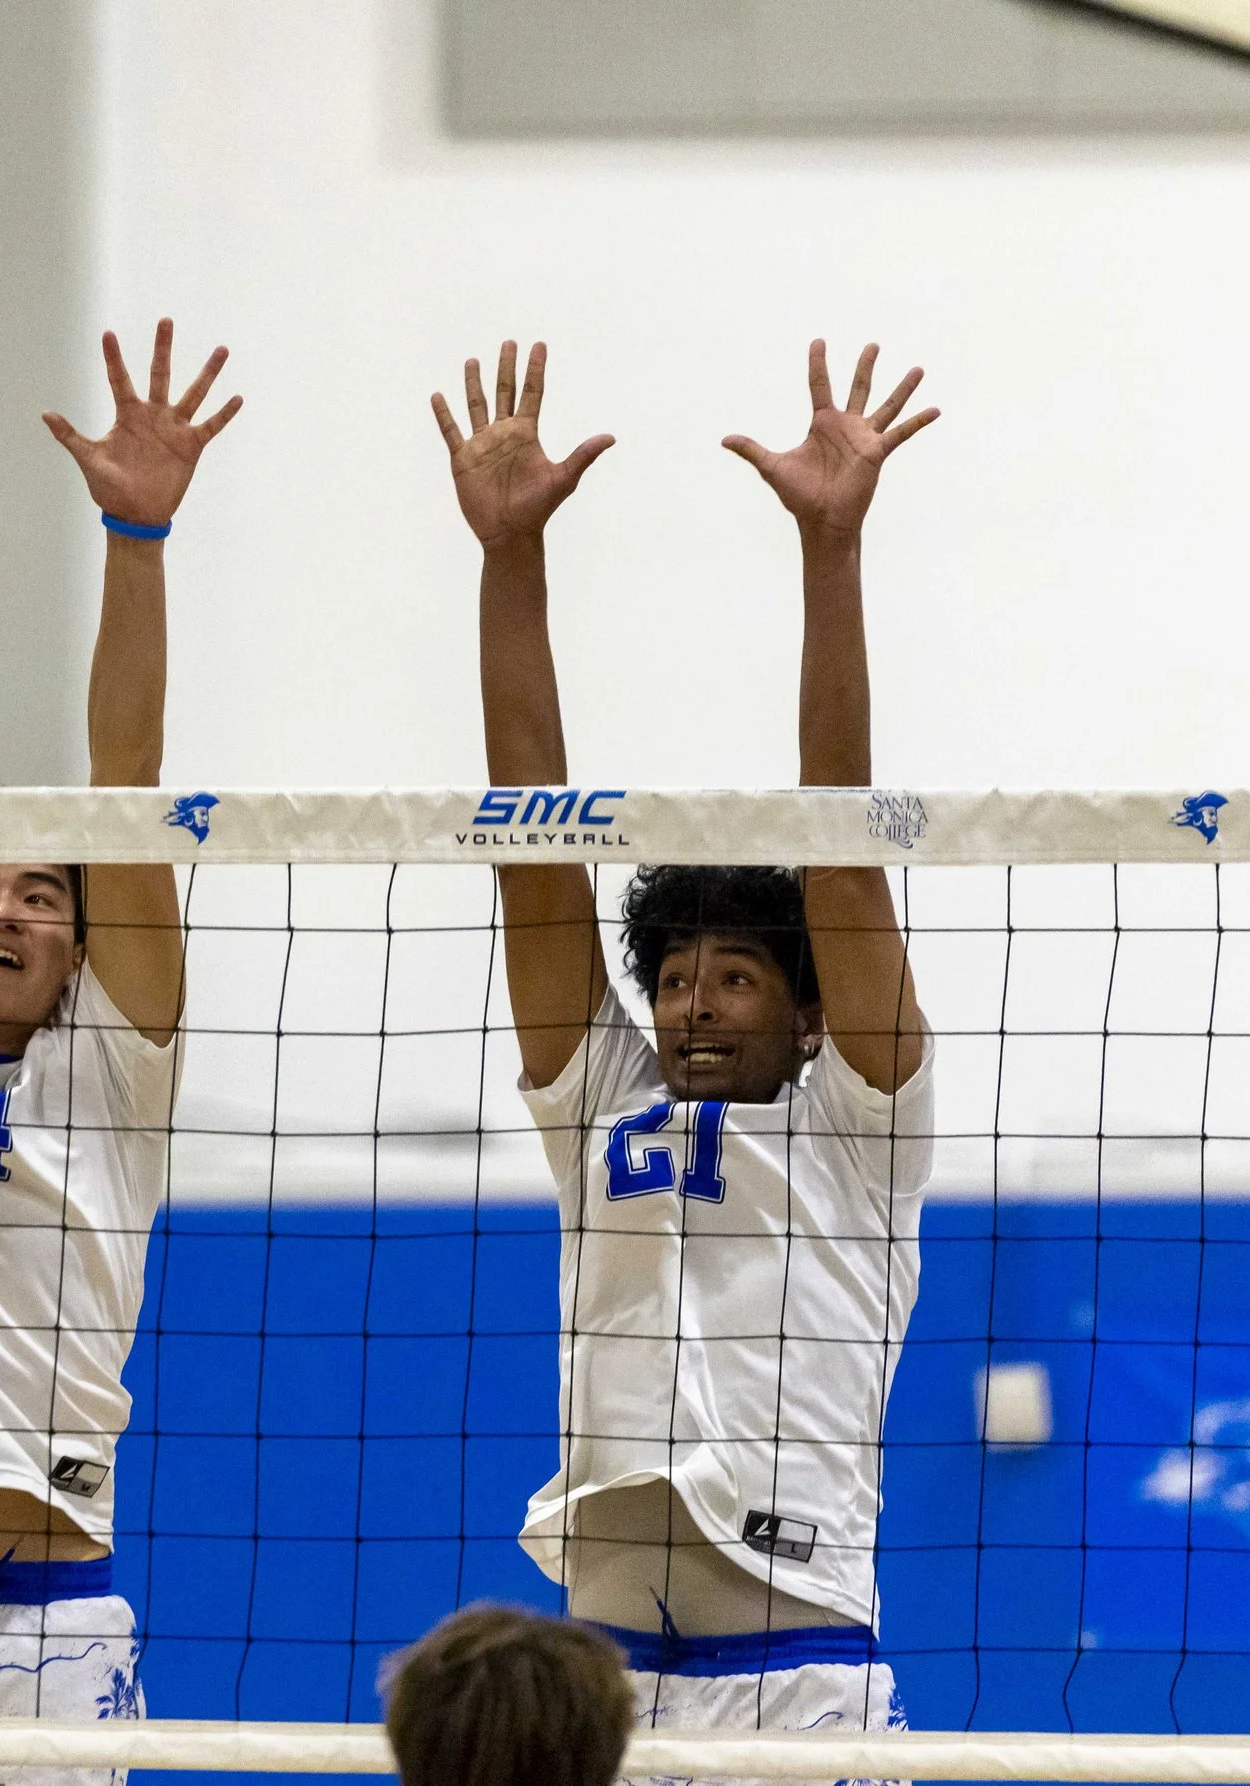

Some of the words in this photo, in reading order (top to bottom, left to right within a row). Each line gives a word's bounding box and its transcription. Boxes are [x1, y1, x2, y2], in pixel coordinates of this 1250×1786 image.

[472, 790, 627, 825] SMC
[871, 794, 923, 810] SANTA
[867, 810, 928, 823] MONICA
[455, 833, 630, 846] VOLLEYBALL
[869, 823, 926, 849] COLLEGE
[604, 1101, 729, 1204] 21
